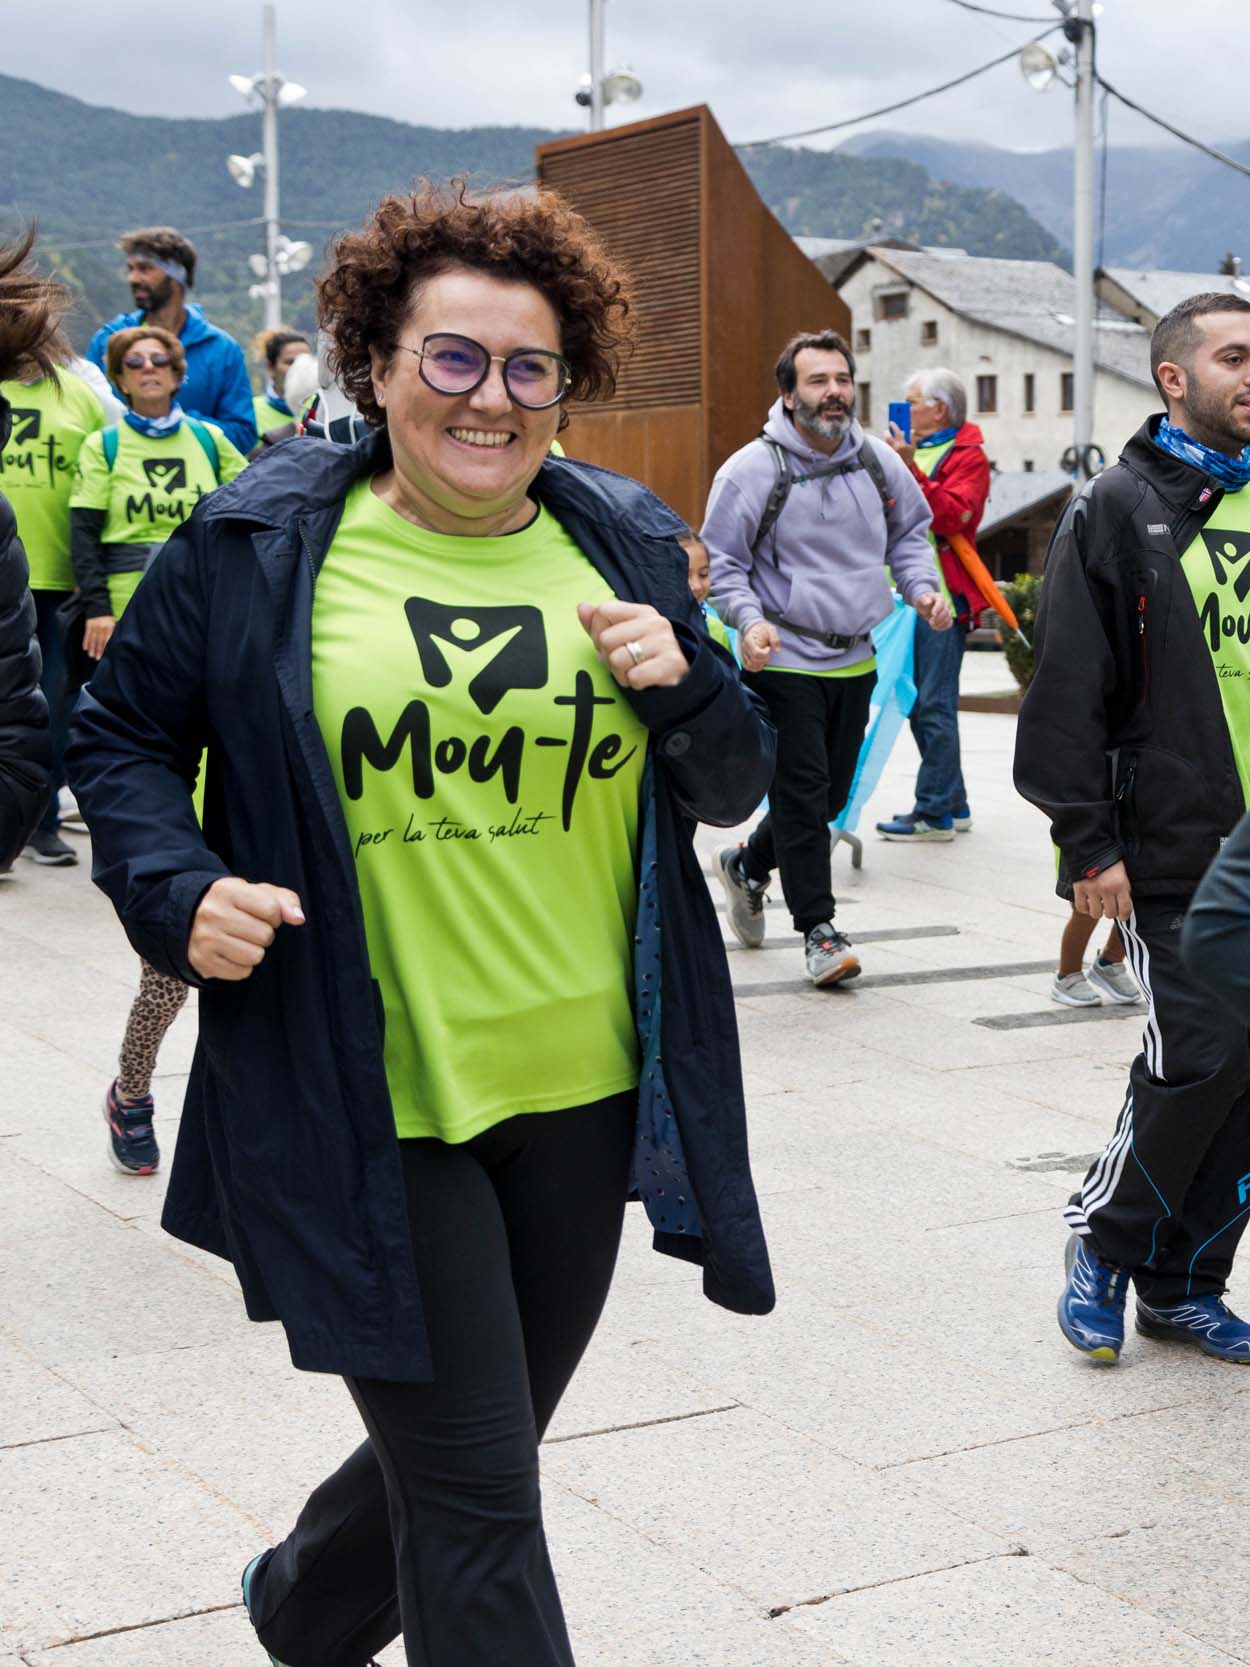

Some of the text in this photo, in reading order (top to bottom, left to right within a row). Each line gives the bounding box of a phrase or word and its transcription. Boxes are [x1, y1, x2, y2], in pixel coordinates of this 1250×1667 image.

[0, 433, 70, 489] ou-te
[125, 484, 205, 524] Mou-
[1216, 663, 1244, 678] teva
[341, 670, 637, 832] Mou-te
[355, 807, 557, 859] per la teva salut
